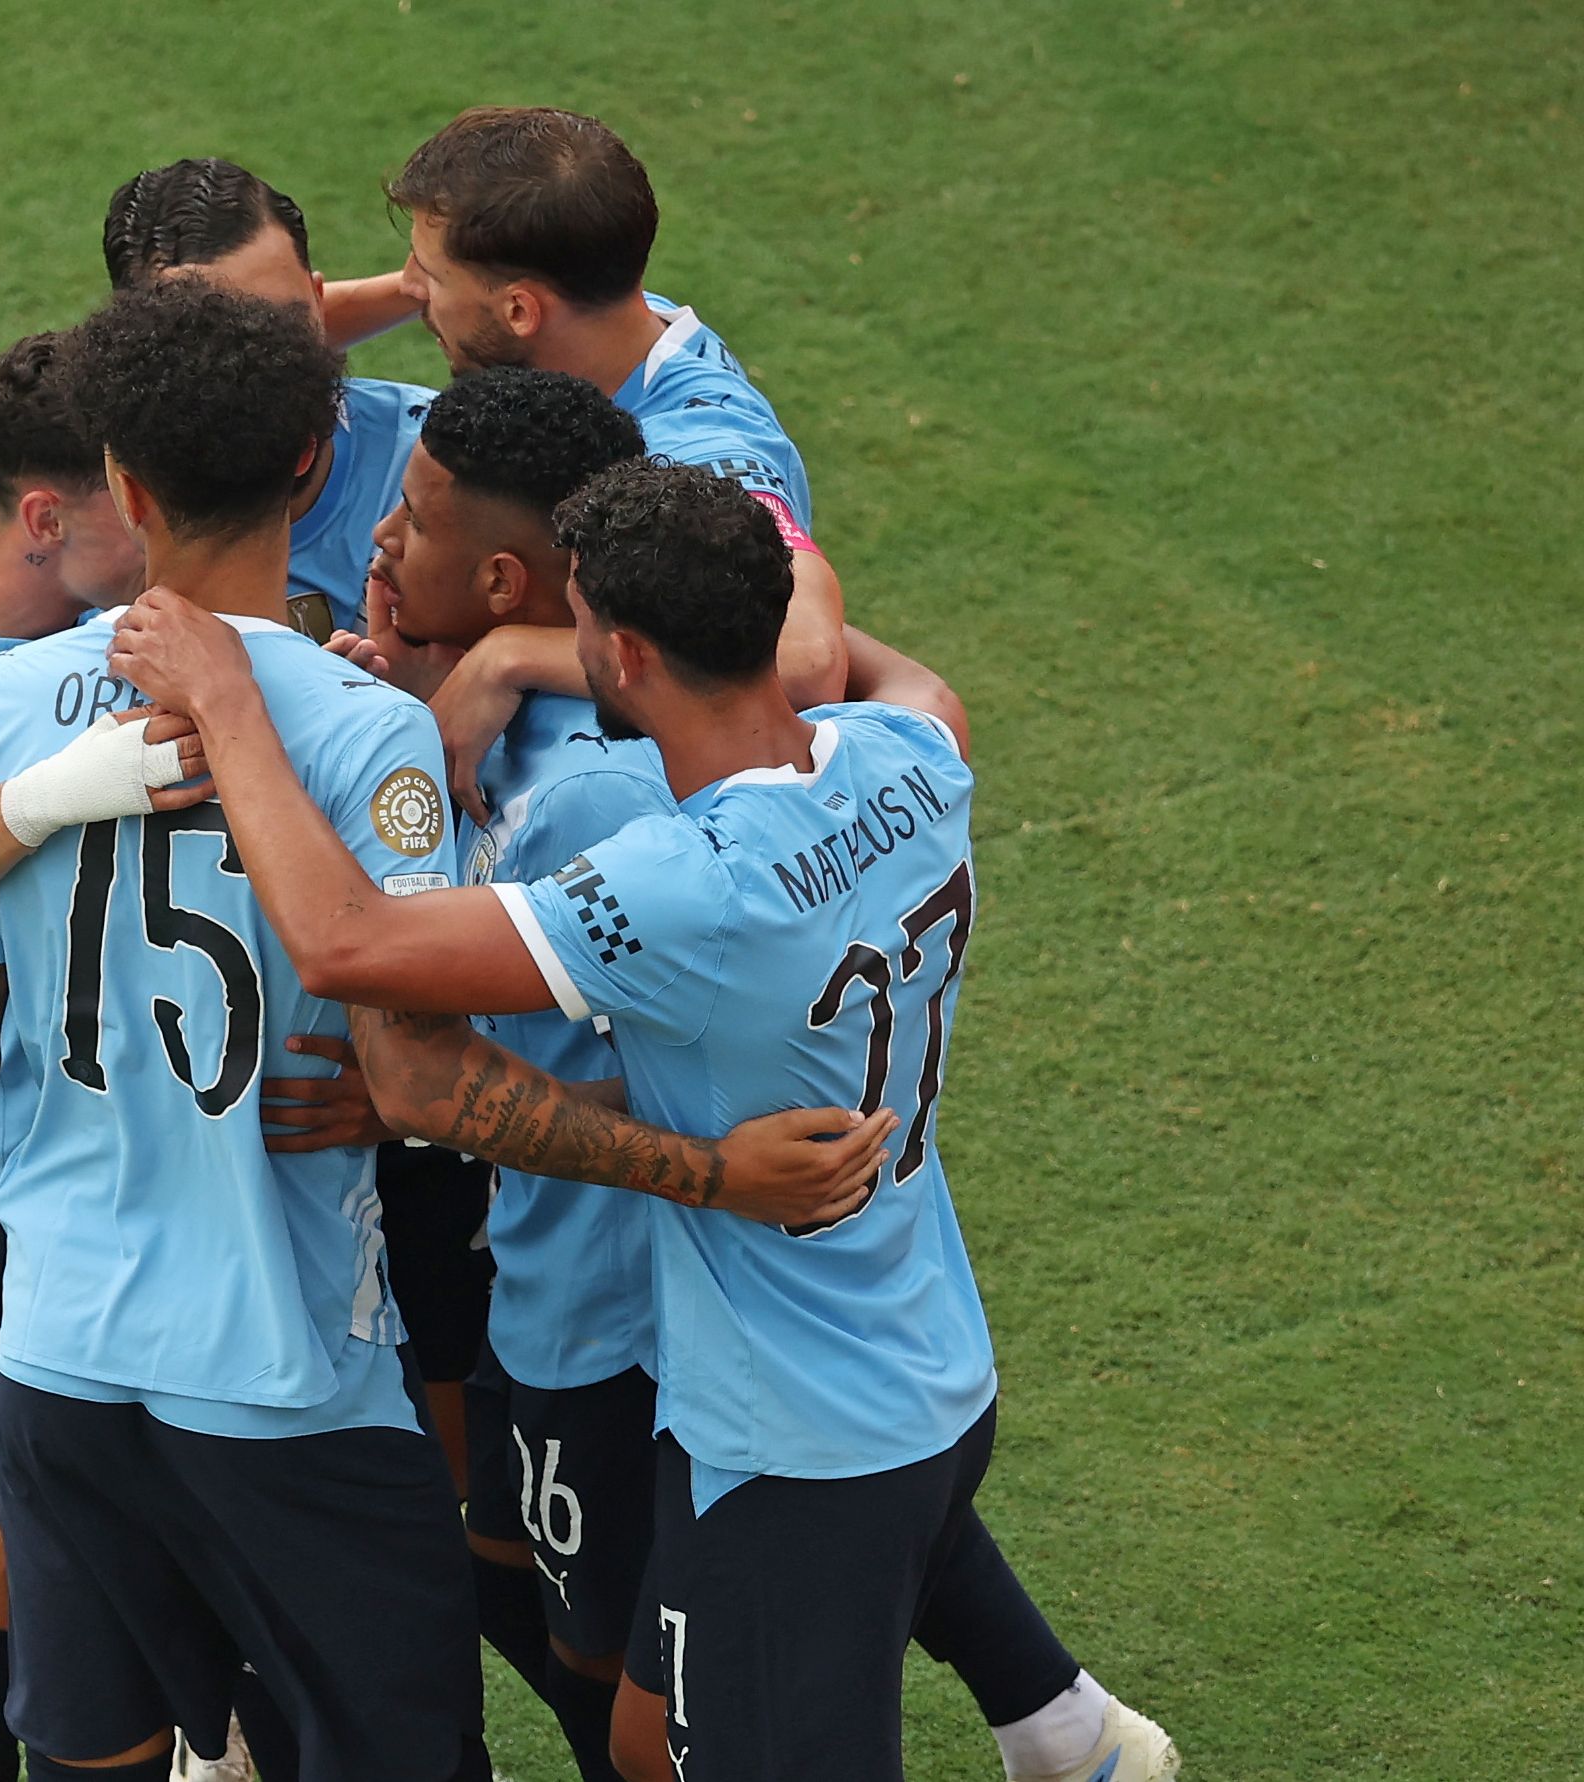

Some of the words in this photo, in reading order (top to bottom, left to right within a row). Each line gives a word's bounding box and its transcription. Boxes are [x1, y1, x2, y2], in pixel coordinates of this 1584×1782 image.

[379, 776, 411, 806] WORLD
[414, 777, 432, 793] CUP
[900, 765, 950, 813] N.
[823, 790, 850, 811] CITY
[379, 810, 396, 837] CLUB
[430, 812, 439, 835] USA
[401, 836, 430, 850] FIFA
[393, 876, 427, 888] FOOTBALL
[59, 799, 264, 1120] 15
[512, 1423, 582, 1555] 16
[659, 1603, 689, 1728] 7
